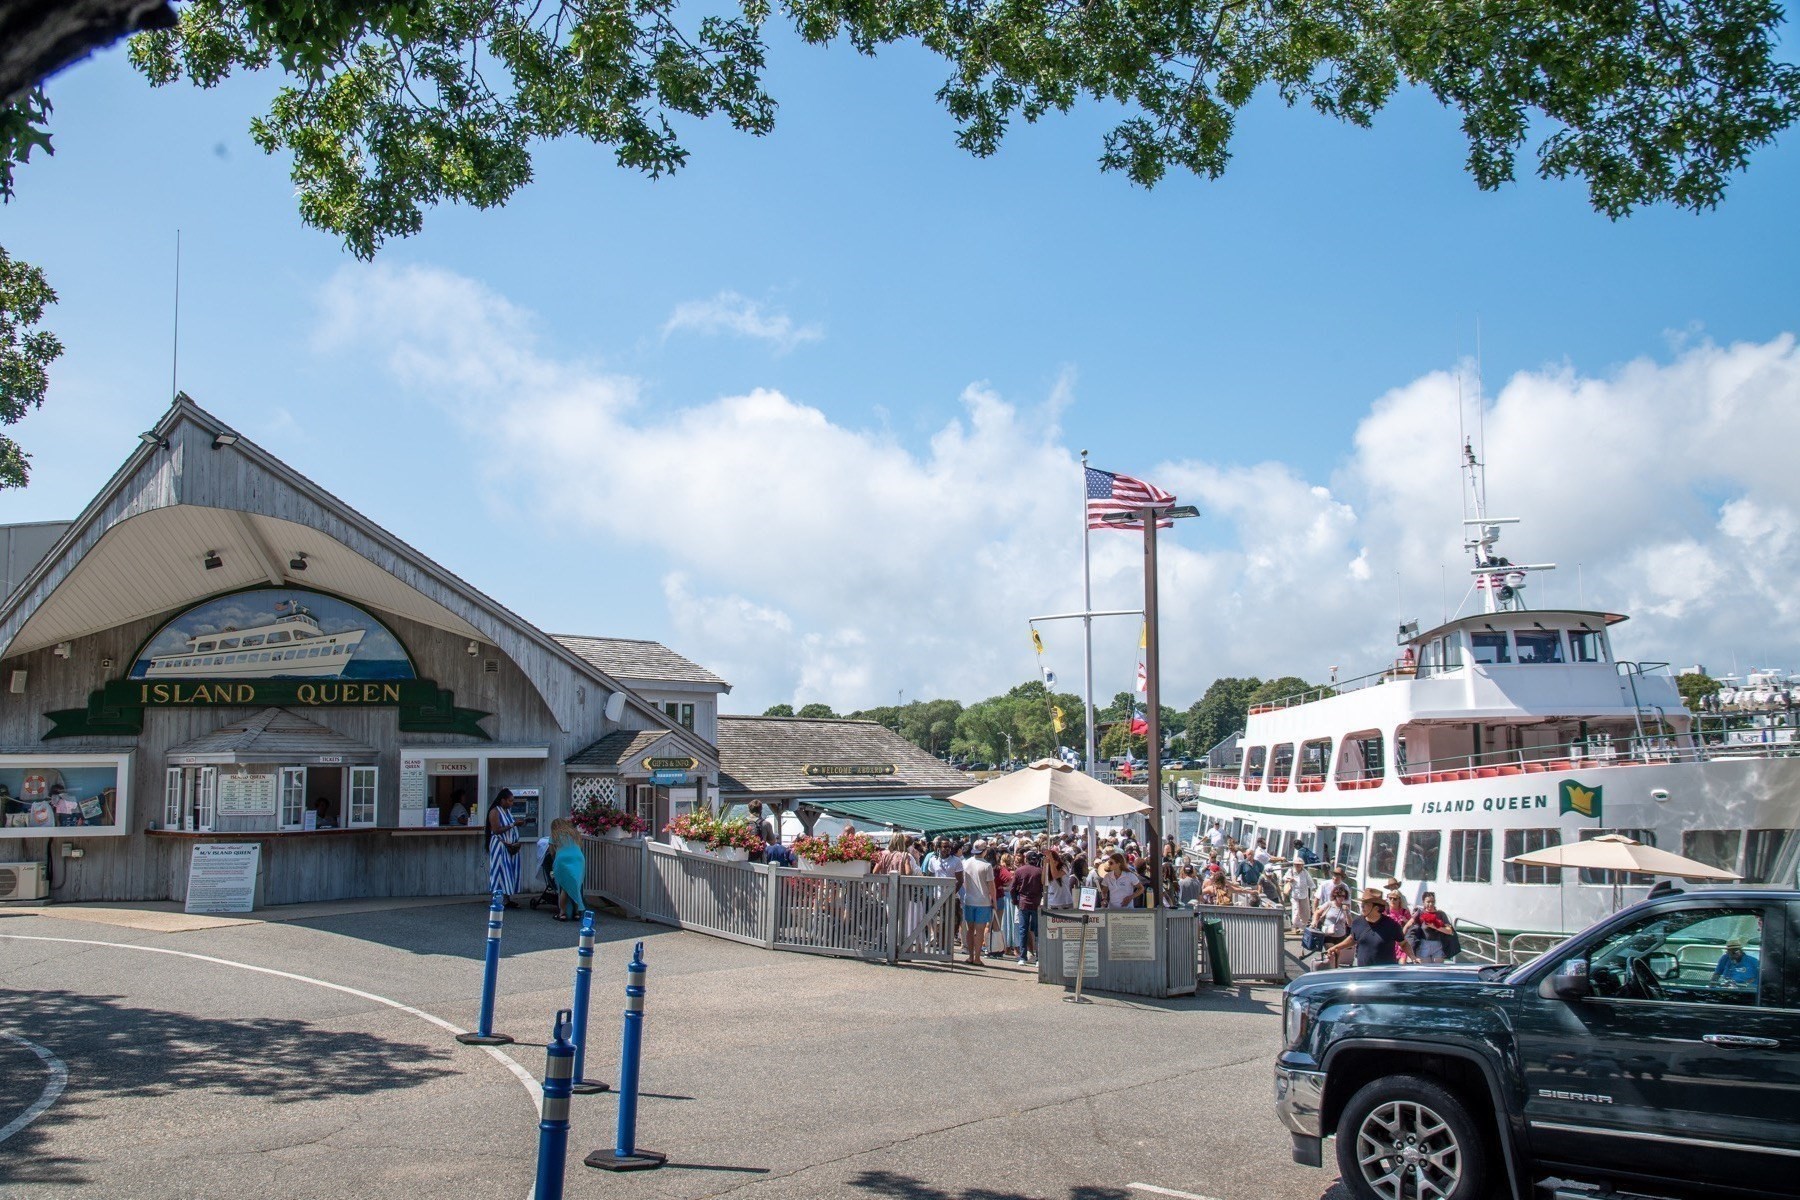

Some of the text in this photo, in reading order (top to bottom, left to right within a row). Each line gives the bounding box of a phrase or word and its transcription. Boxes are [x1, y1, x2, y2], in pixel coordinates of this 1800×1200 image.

[140, 684, 401, 703] ISLAND QUEEN
[1421, 795, 1547, 814] ISLAND QUEEN
[1538, 1089, 1613, 1103] SIERRA
